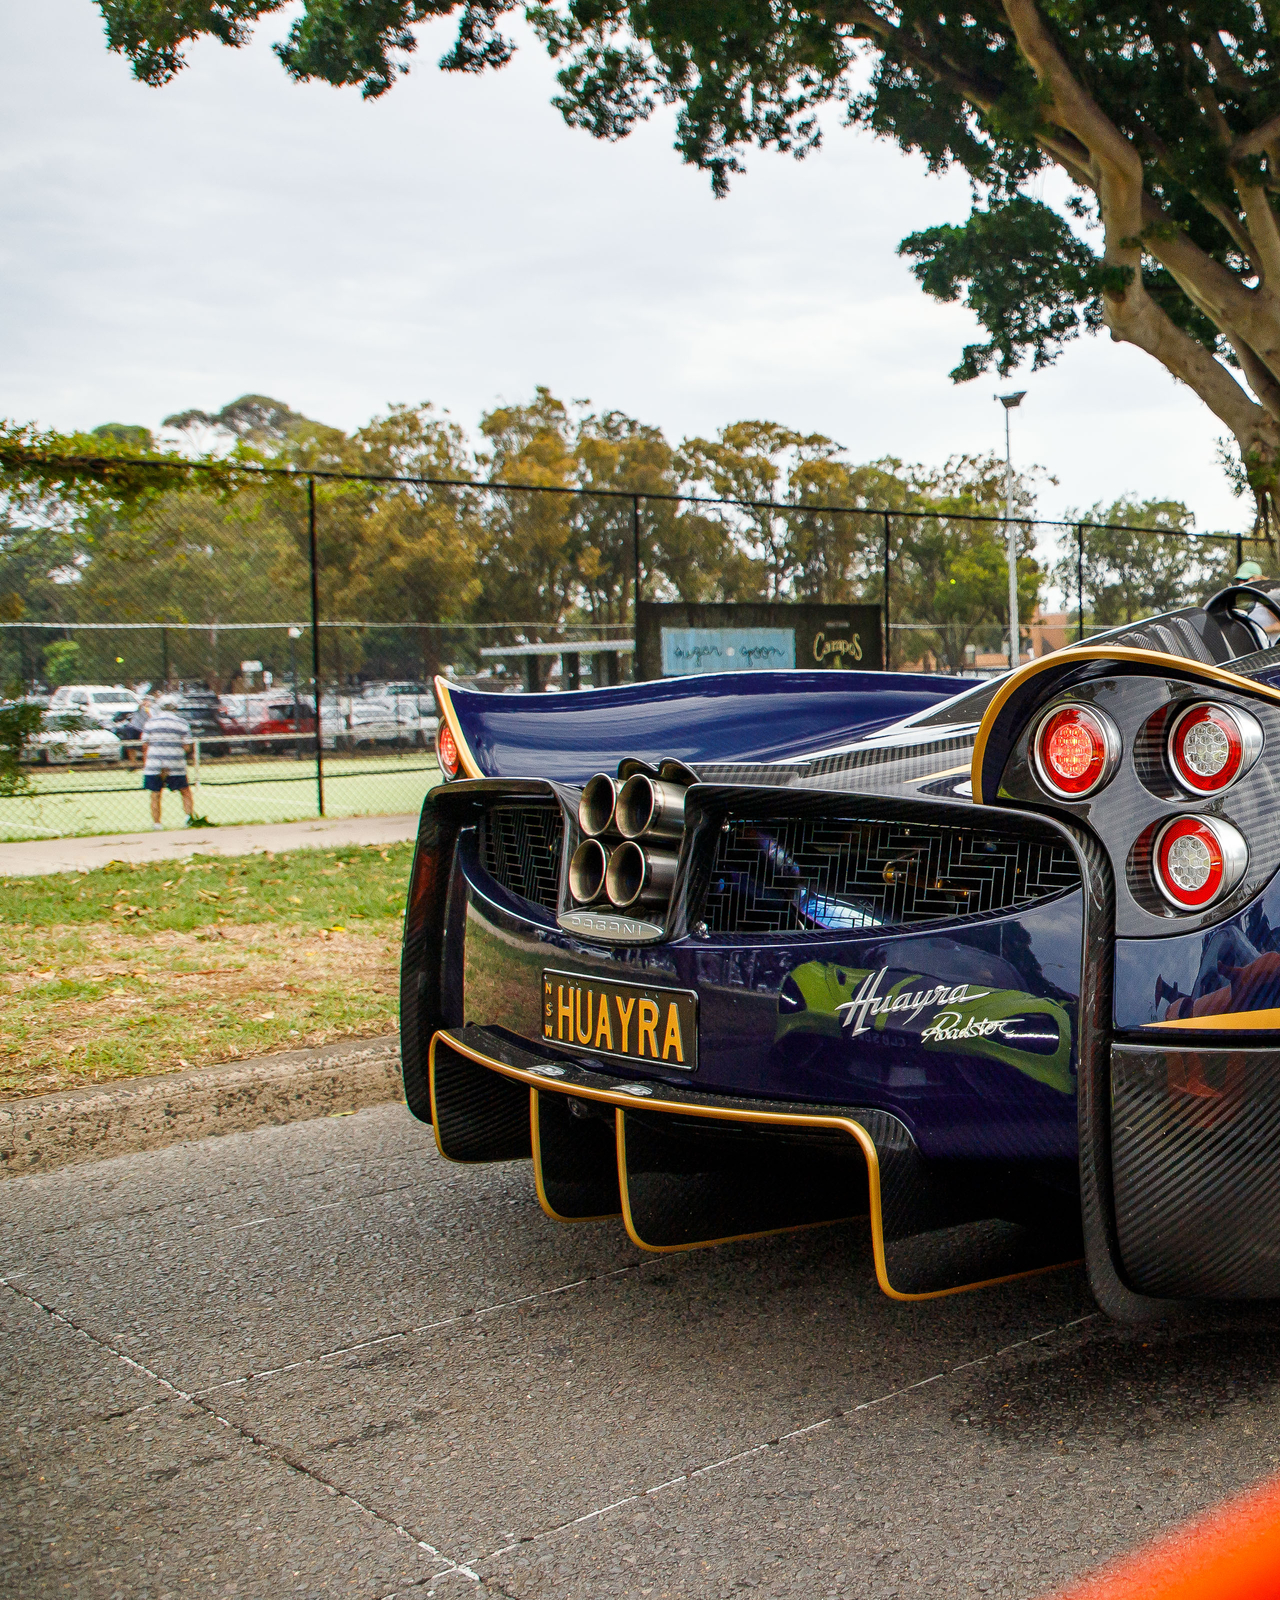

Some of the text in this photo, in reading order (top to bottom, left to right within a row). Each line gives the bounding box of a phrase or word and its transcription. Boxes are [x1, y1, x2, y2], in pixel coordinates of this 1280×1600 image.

[571, 916, 642, 937] PAGANI
[544, 982, 554, 1038] NSW
[557, 984, 684, 1063] HUAYRA
[834, 965, 991, 1037] Huayra
[920, 1011, 1025, 1044] Roadster
